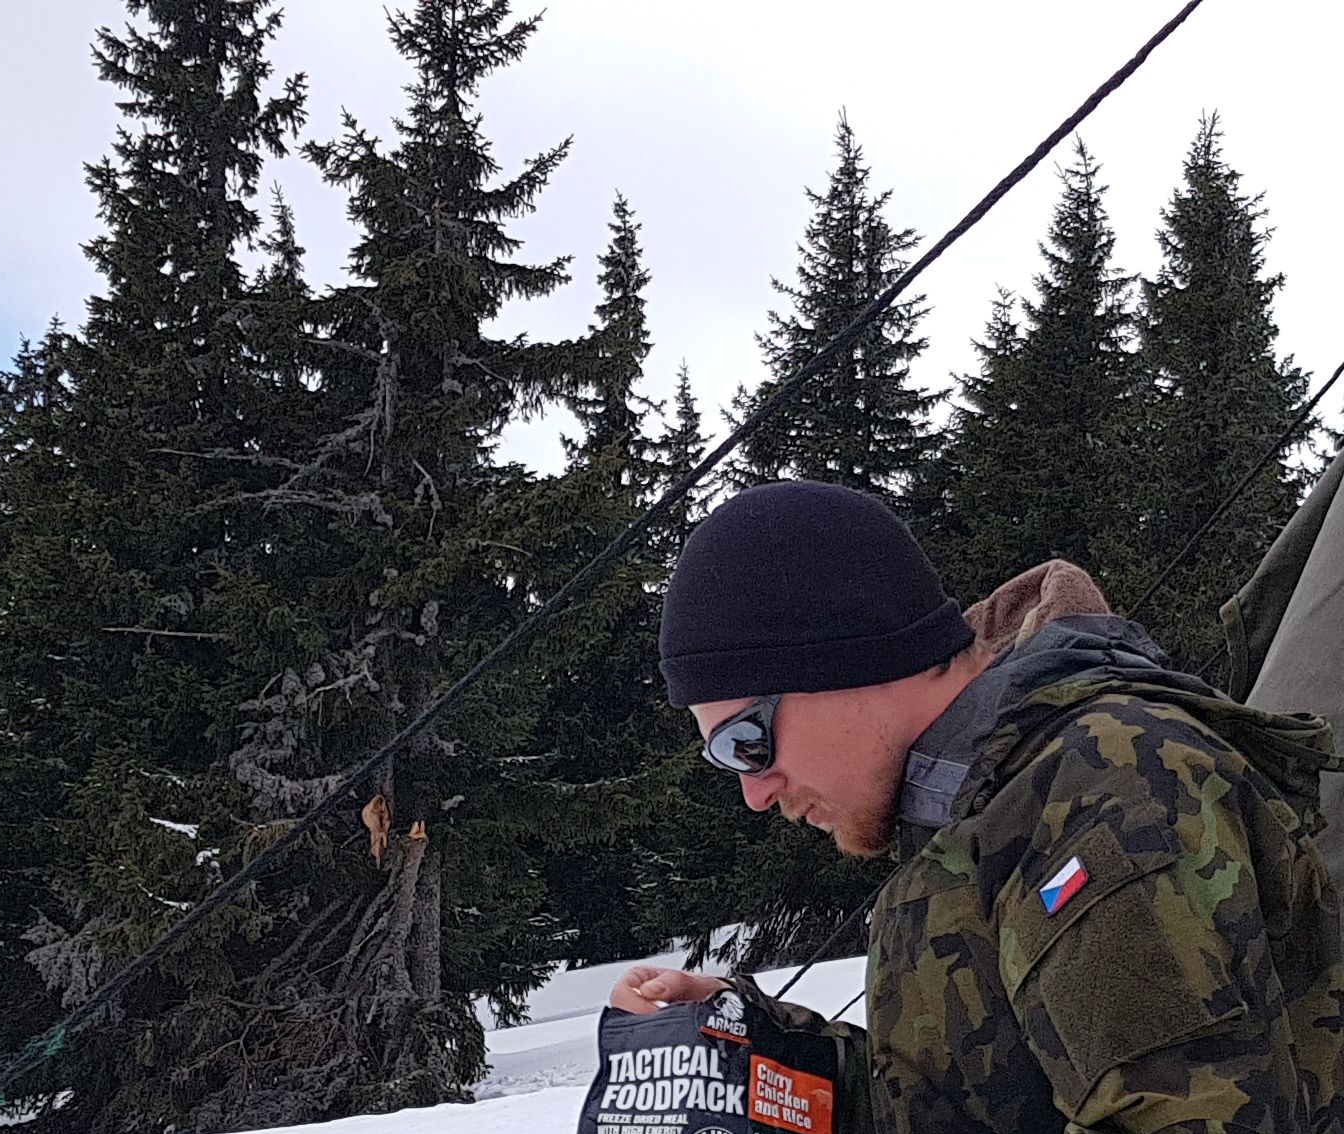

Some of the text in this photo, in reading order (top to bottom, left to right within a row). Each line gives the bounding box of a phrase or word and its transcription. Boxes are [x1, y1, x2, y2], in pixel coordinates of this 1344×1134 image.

[706, 1015, 747, 1037] ARMED
[608, 1045, 724, 1083] TACTICAL
[757, 1063, 793, 1092] Curry
[600, 1078, 745, 1115] FOODPACK
[756, 1081, 809, 1113] Chicken
[597, 1113, 689, 1125] FREEZE DRIED MEAL
[754, 1099, 812, 1130] and Rice
